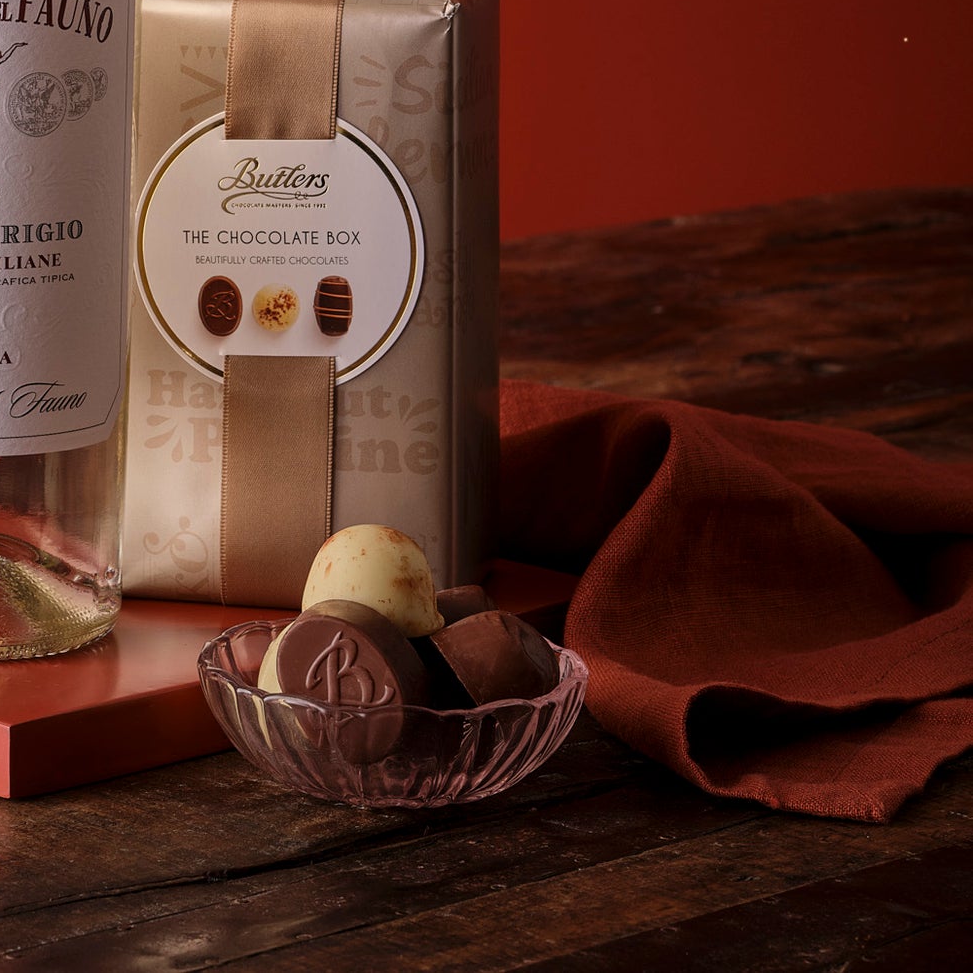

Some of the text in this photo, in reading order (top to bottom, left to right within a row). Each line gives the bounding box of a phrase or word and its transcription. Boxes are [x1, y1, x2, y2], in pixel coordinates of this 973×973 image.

[217, 157, 330, 200] Butlers
[182, 230, 361, 245] THE CHOCOLATE BOX
[195, 255, 349, 265] BEAUTIFULLY CRAFTED CHOCOLATES
[40, 273, 75, 284] TIPICA
[9, 380, 88, 419] Fauno
